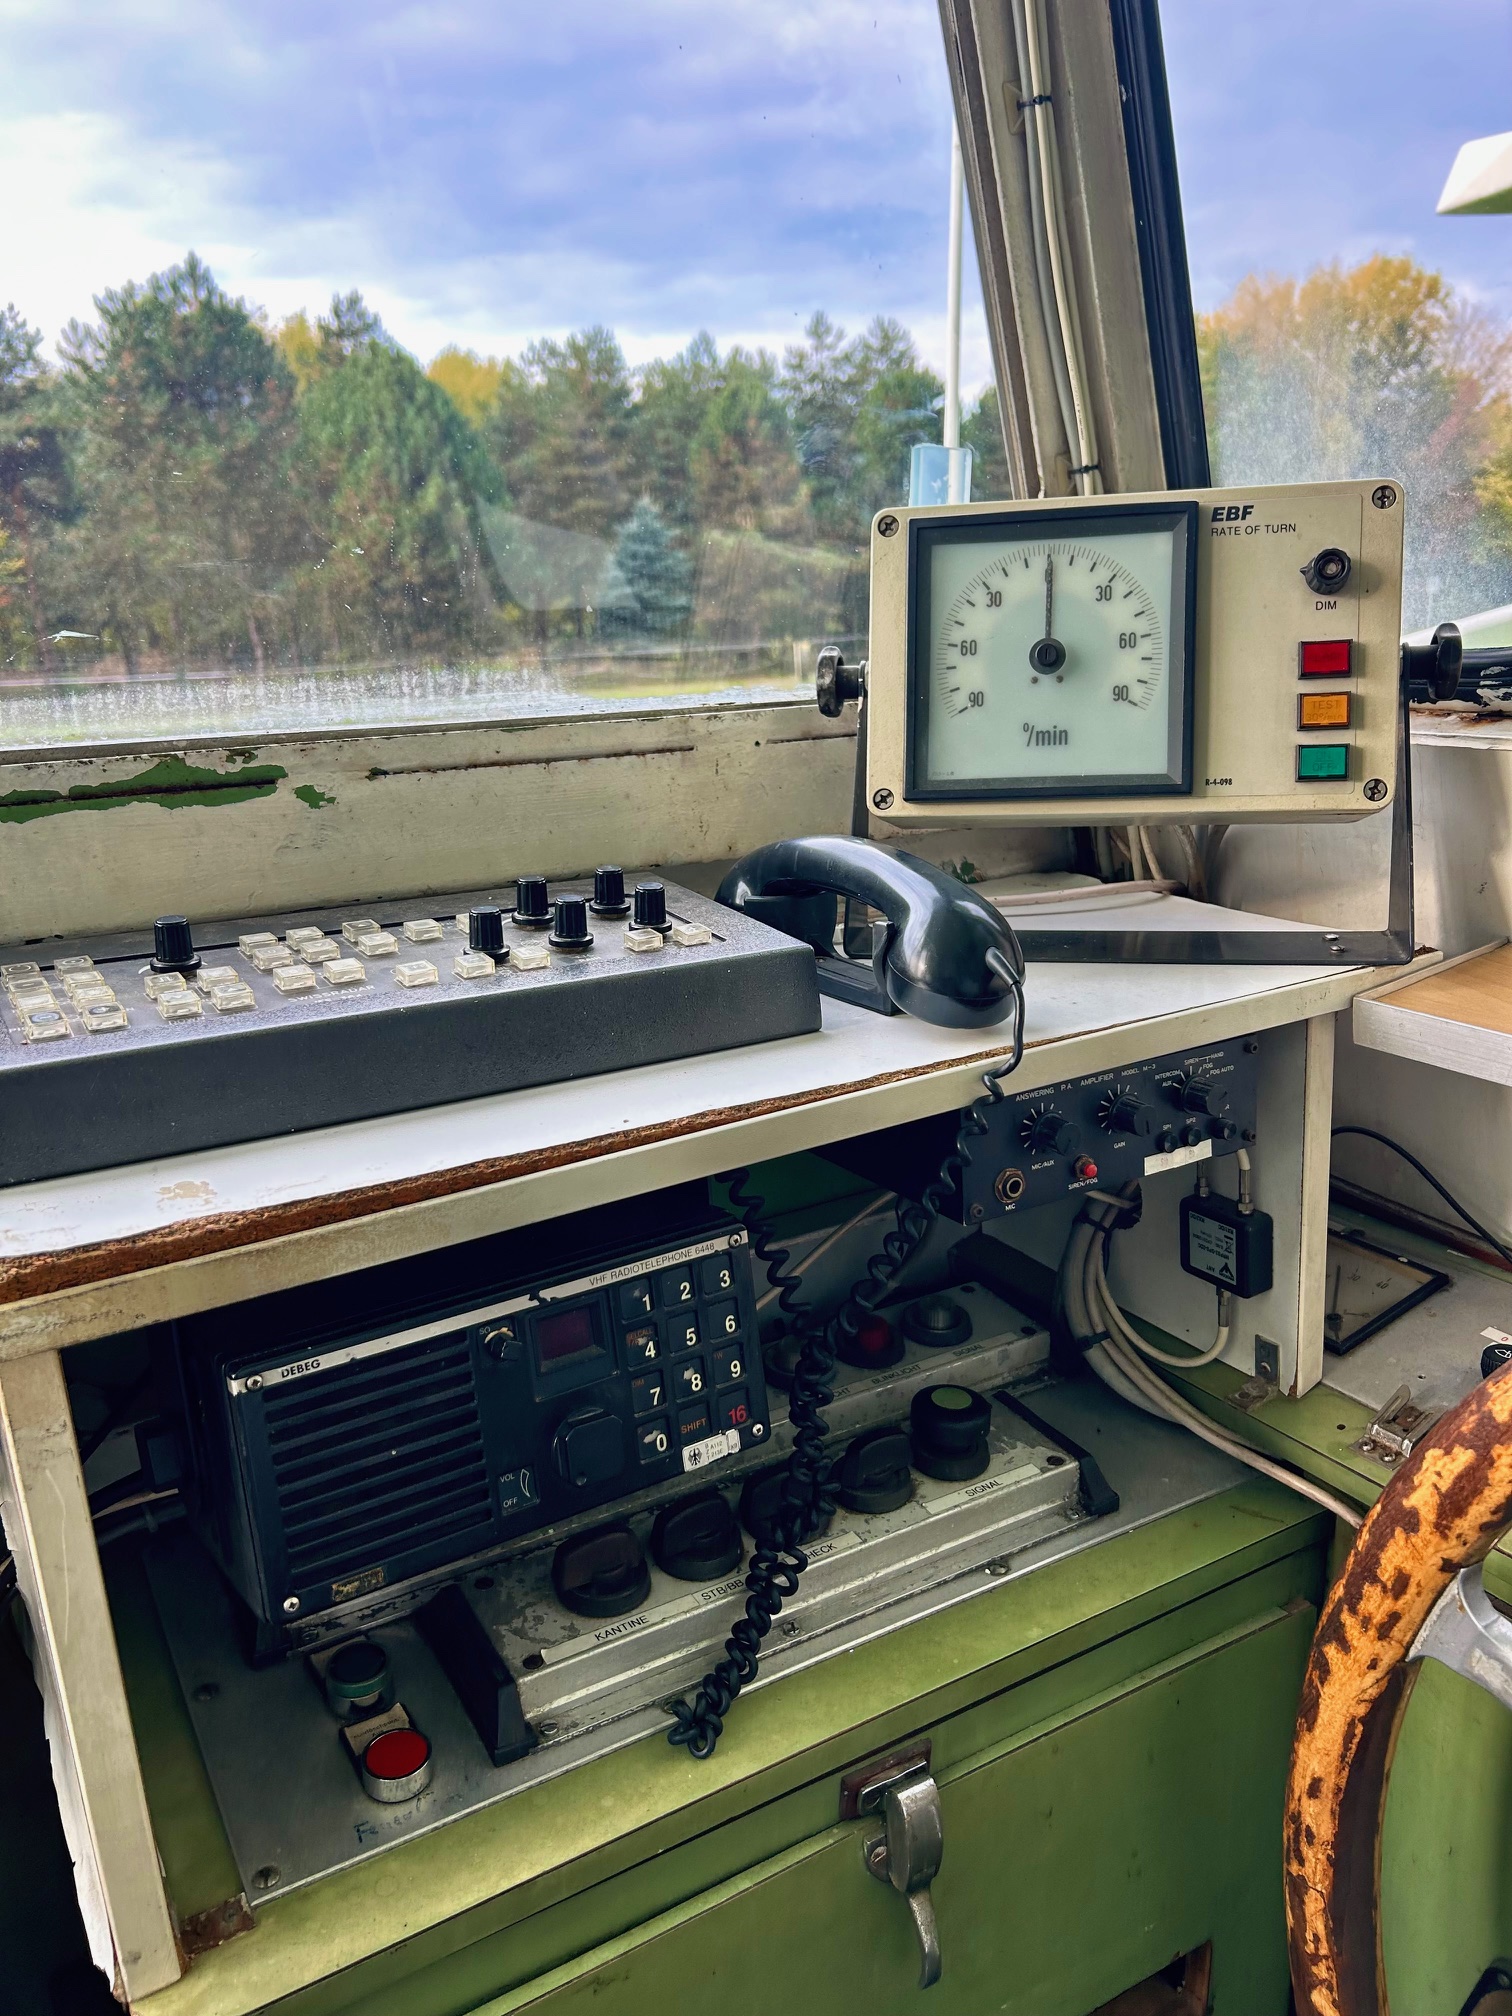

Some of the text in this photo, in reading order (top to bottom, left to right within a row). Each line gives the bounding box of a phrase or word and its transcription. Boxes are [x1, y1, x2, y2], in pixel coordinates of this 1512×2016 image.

[1211, 504, 1254, 522] EBF
[1211, 523, 1297, 537] RATE OF TURN
[985, 591, 1003, 609] 30
[1095, 584, 1113, 602] 30
[1315, 600, 1337, 611] DIM
[960, 639, 978, 657] 60
[1118, 632, 1137, 650] 60
[968, 691, 985, 708] 90
[1112, 684, 1129, 702] 90
[1312, 699, 1339, 710] TEST
[288, 984, 375, 1002] SWISSRADAR
[1184, 1058, 1199, 1066] SIREN
[1016, 1088, 1054, 1102] ANSWERING
[1080, 1072, 1114, 1086] AMPLIFIER
[1121, 1068, 1140, 1076] MODEL
[1142, 1064, 1156, 1072] M-3
[1154, 1070, 1180, 1080] INTERCOM
[1113, 1141, 1126, 1149] GAIN
[1031, 1159, 1055, 1171] MIC/AUX
[1068, 1178, 1098, 1190] SIREN/FOG
[1005, 1203, 1016, 1211] MIC
[588, 1242, 715, 1286] VHF RADIOTELEPHONE 6448
[720, 1270, 731, 1288] 3
[1376, 1280, 1390, 1290] 40
[680, 1282, 692, 1300] 2
[642, 1293, 650, 1312] 1
[725, 1314, 736, 1333] 6
[686, 1327, 697, 1346] 5
[645, 1341, 656, 1358] 4
[952, 1343, 986, 1357] SIGNAL
[281, 1359, 320, 1378] DEBEG
[730, 1360, 741, 1378] 9
[691, 1374, 702, 1392] 8
[832, 1364, 922, 1399] CHT BLINKLICHT
[650, 1386, 660, 1406] 7
[728, 1404, 746, 1424] 16
[680, 1418, 707, 1434] SHIFT
[656, 1434, 667, 1452] 0
[500, 1474, 515, 1483] VOL
[964, 1478, 1003, 1498] SIGNAL
[503, 1497, 518, 1508] OFF
[594, 1615, 650, 1642] KANTINE
[701, 1579, 744, 1602] STB/BB
